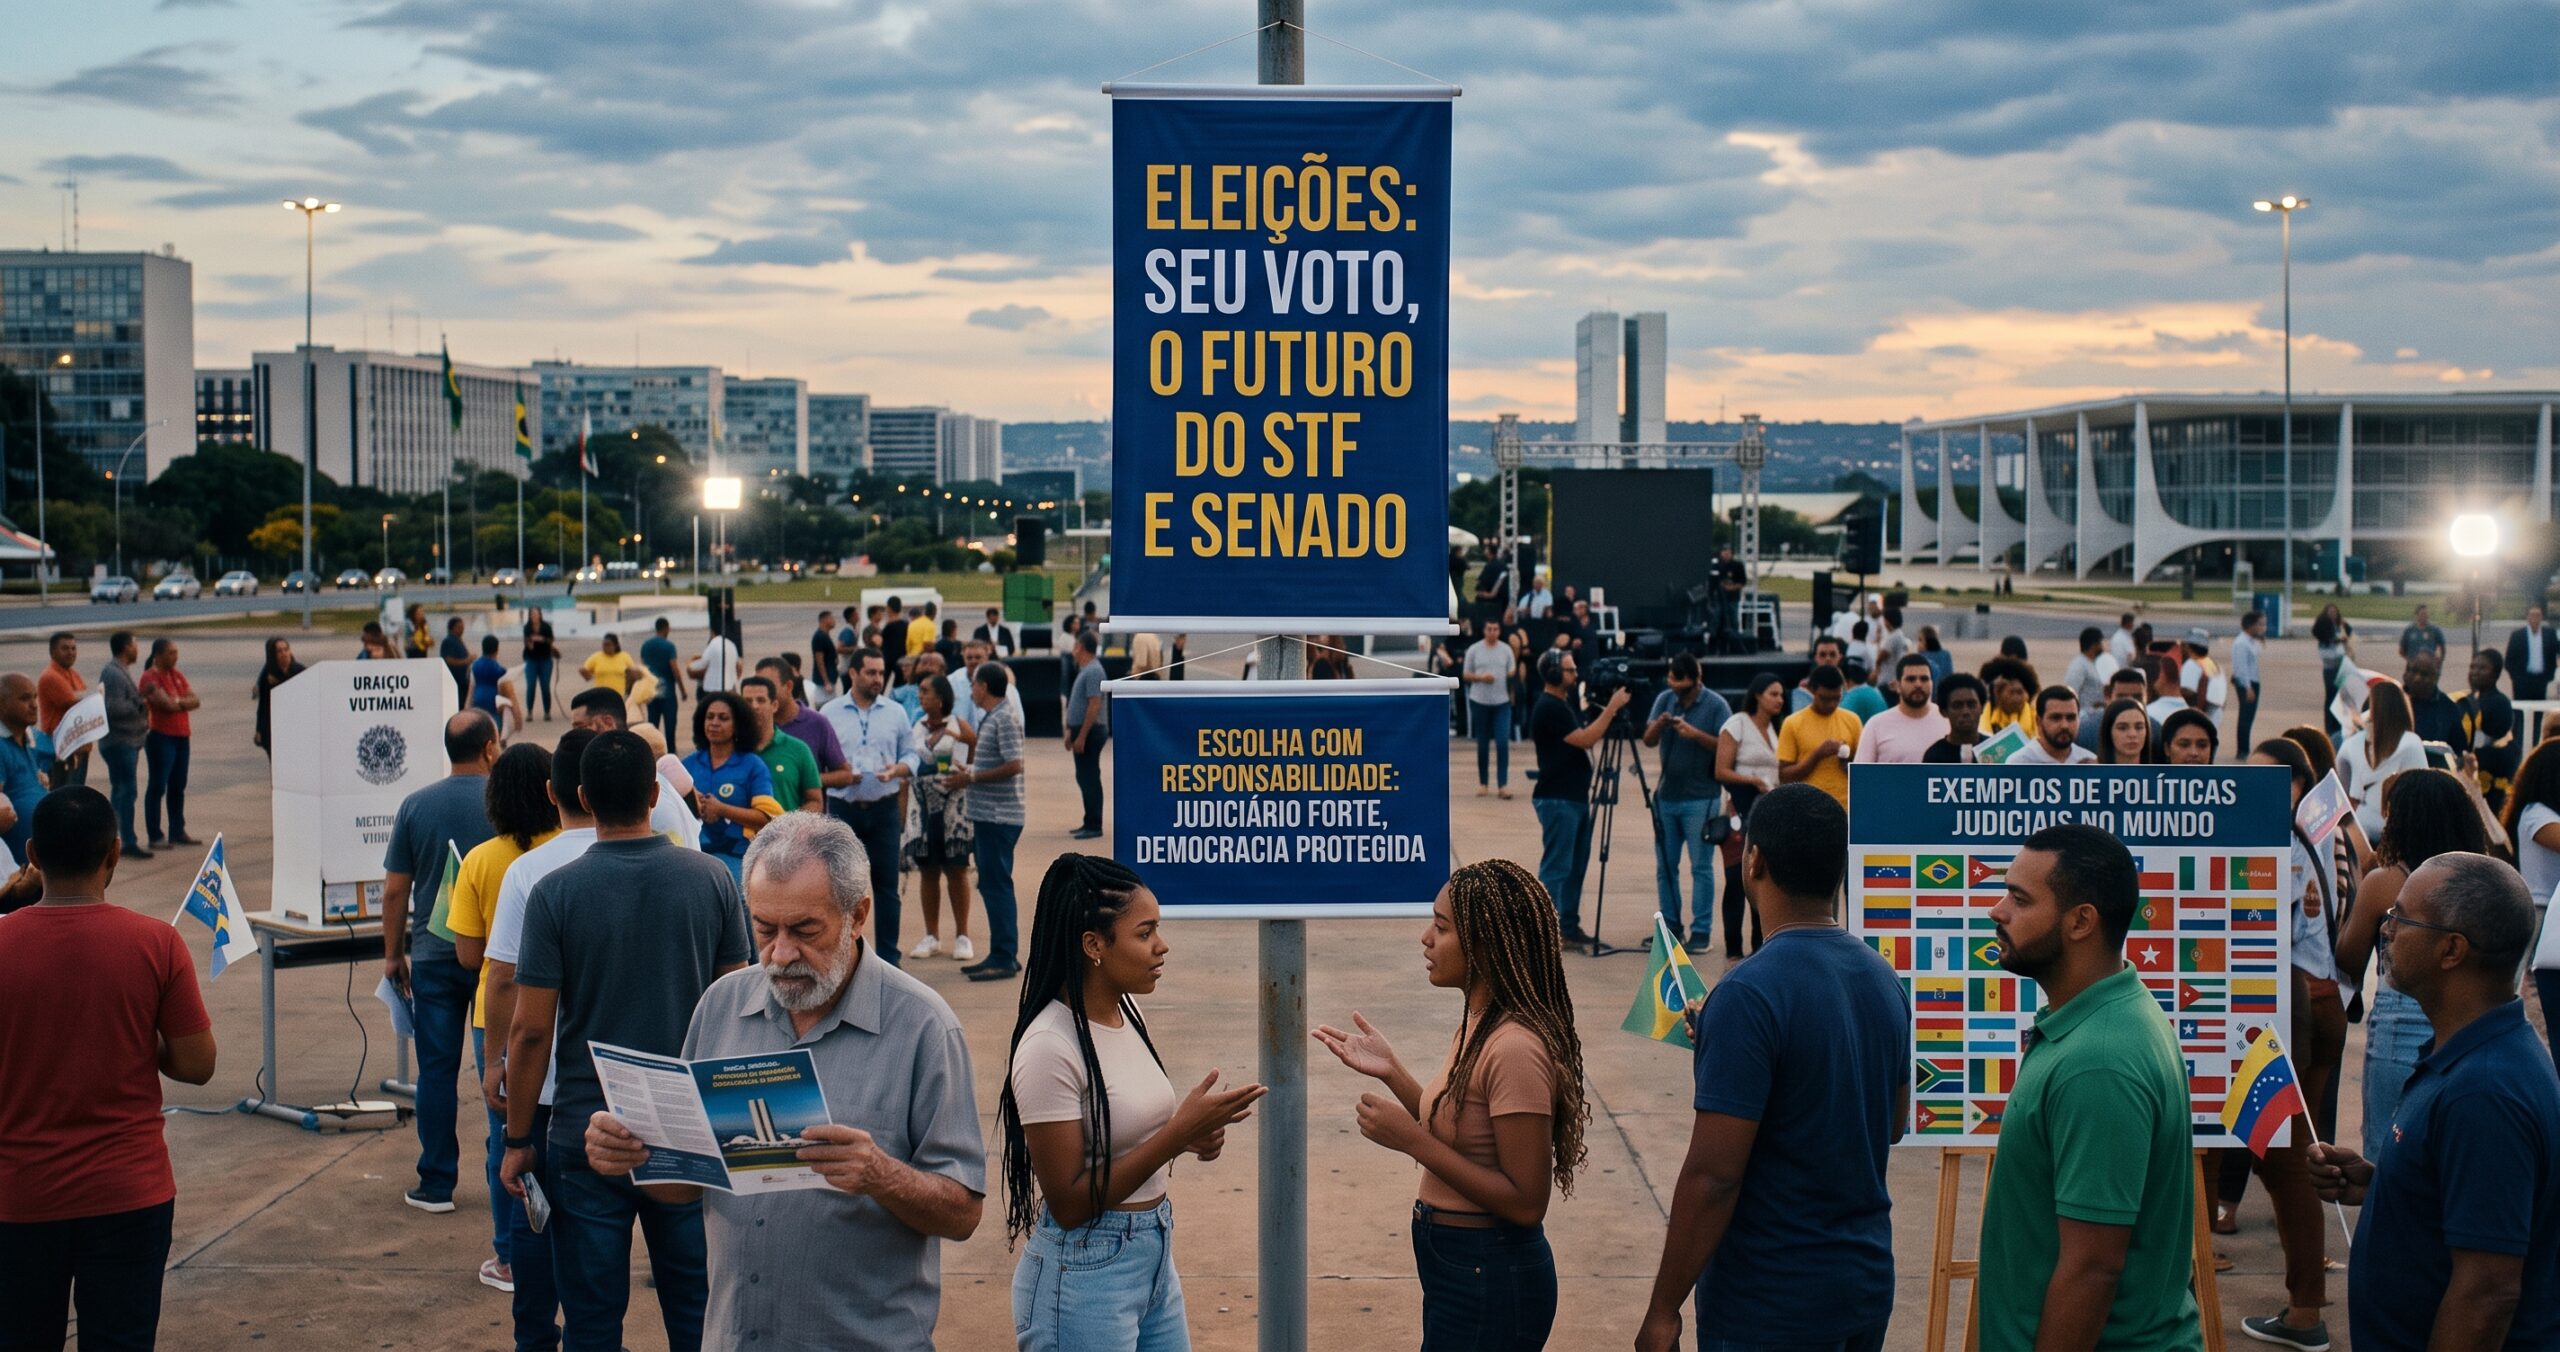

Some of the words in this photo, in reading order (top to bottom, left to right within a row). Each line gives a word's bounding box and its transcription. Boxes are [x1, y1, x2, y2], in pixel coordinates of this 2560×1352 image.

[1146, 152, 1417, 244] ELEIÇÕES:
[1144, 248, 1246, 314] SEU
[1263, 249, 1419, 323] VOTO,
[1150, 330, 1183, 395] O
[1202, 330, 1413, 397] FUTURO
[1176, 411, 1246, 477] DO
[1262, 411, 1361, 477] STF
[1144, 492, 1174, 557] E
[1191, 492, 1407, 558] SENADO
[353, 675, 410, 693] URAIÇIO
[349, 695, 414, 712] VUTIMIAL
[1198, 728, 1304, 757] ESCOLHA
[1311, 728, 1363, 756] COM
[1162, 763, 1400, 792] RESPONSABILIDADE:
[1927, 777, 2062, 804] EXEMPLOS
[2069, 778, 2101, 804] DE
[2108, 773, 2236, 805] POLÍTICAS
[1173, 795, 1301, 828] JUDICIÁRIO
[1308, 799, 1388, 830] FORTE,
[2081, 810, 2115, 834] NO
[2123, 811, 2214, 837] MUNDO
[1136, 835, 1290, 864] DEMOCRACIA
[1296, 834, 1426, 863] PROTEGIDA
